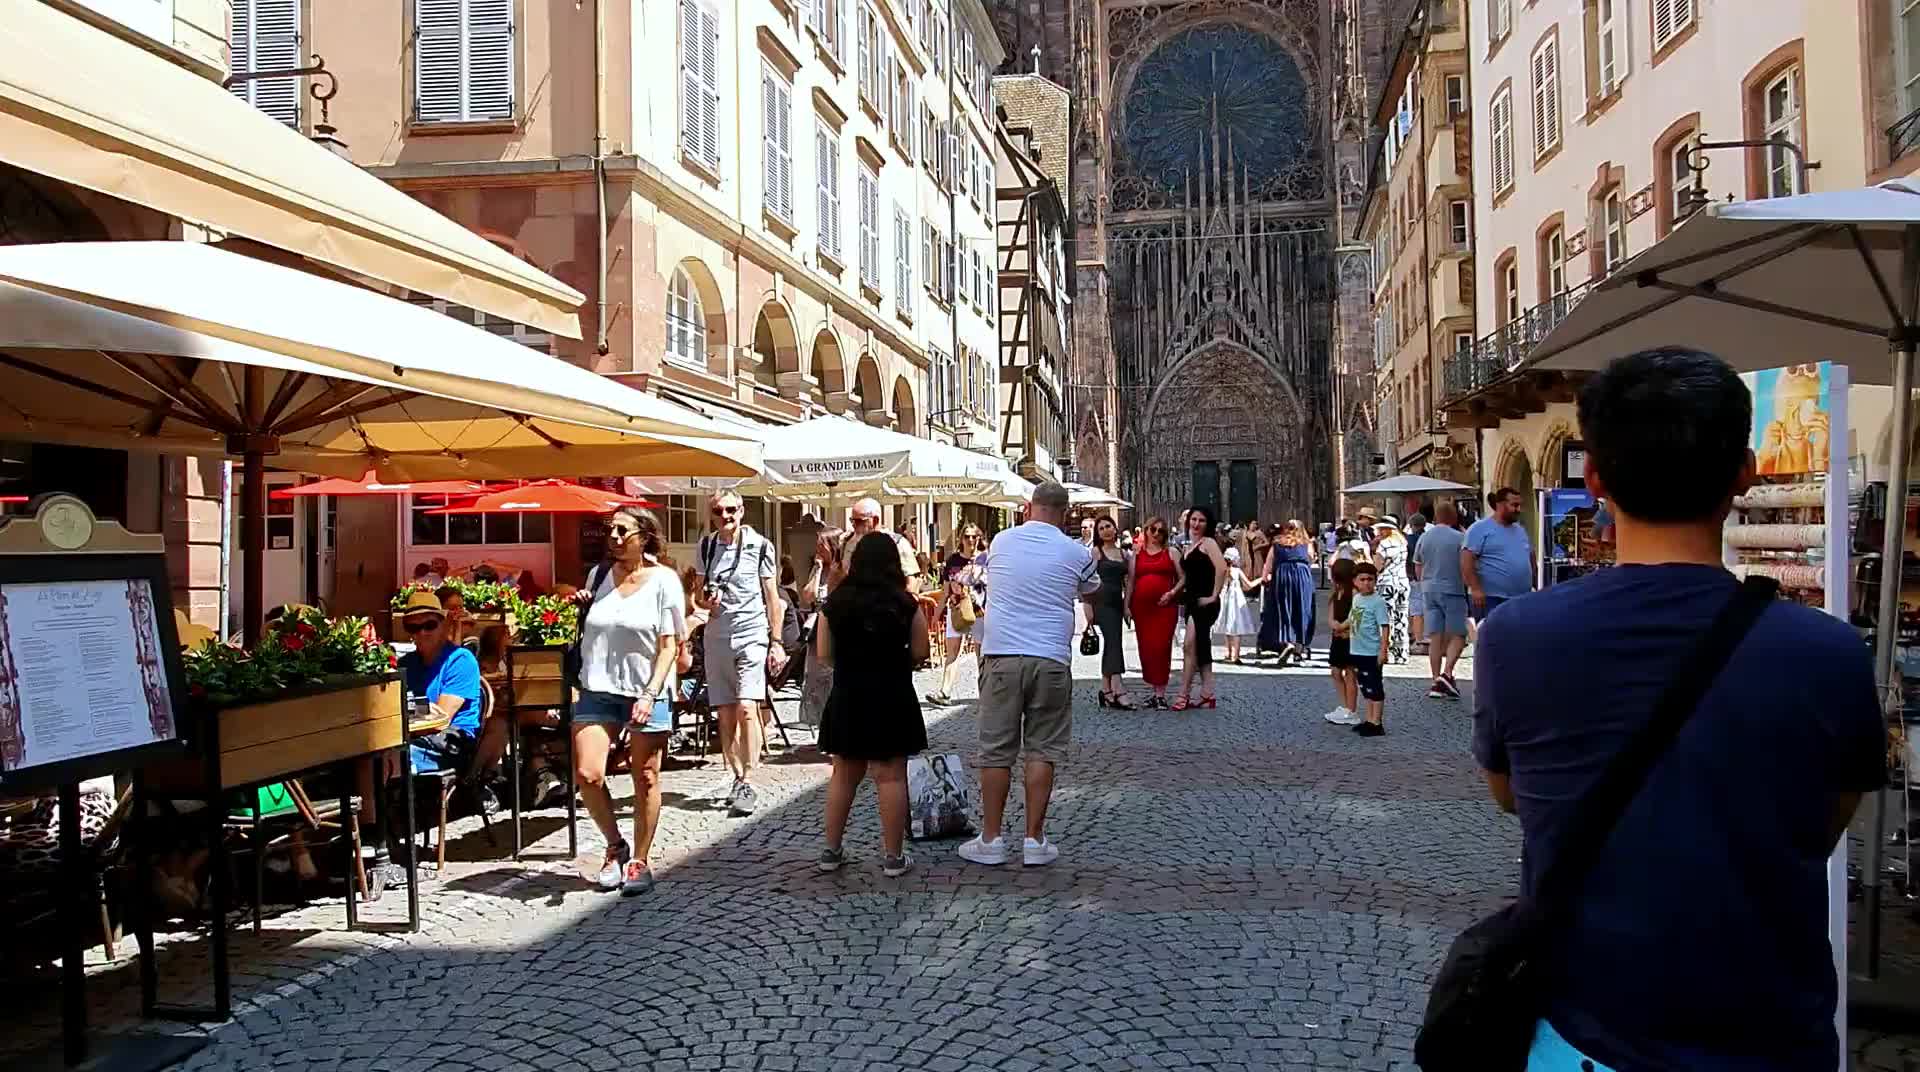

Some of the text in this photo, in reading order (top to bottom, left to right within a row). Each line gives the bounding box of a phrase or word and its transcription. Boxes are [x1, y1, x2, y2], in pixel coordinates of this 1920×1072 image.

[790, 458, 885, 474] LA GRANDE DAME
